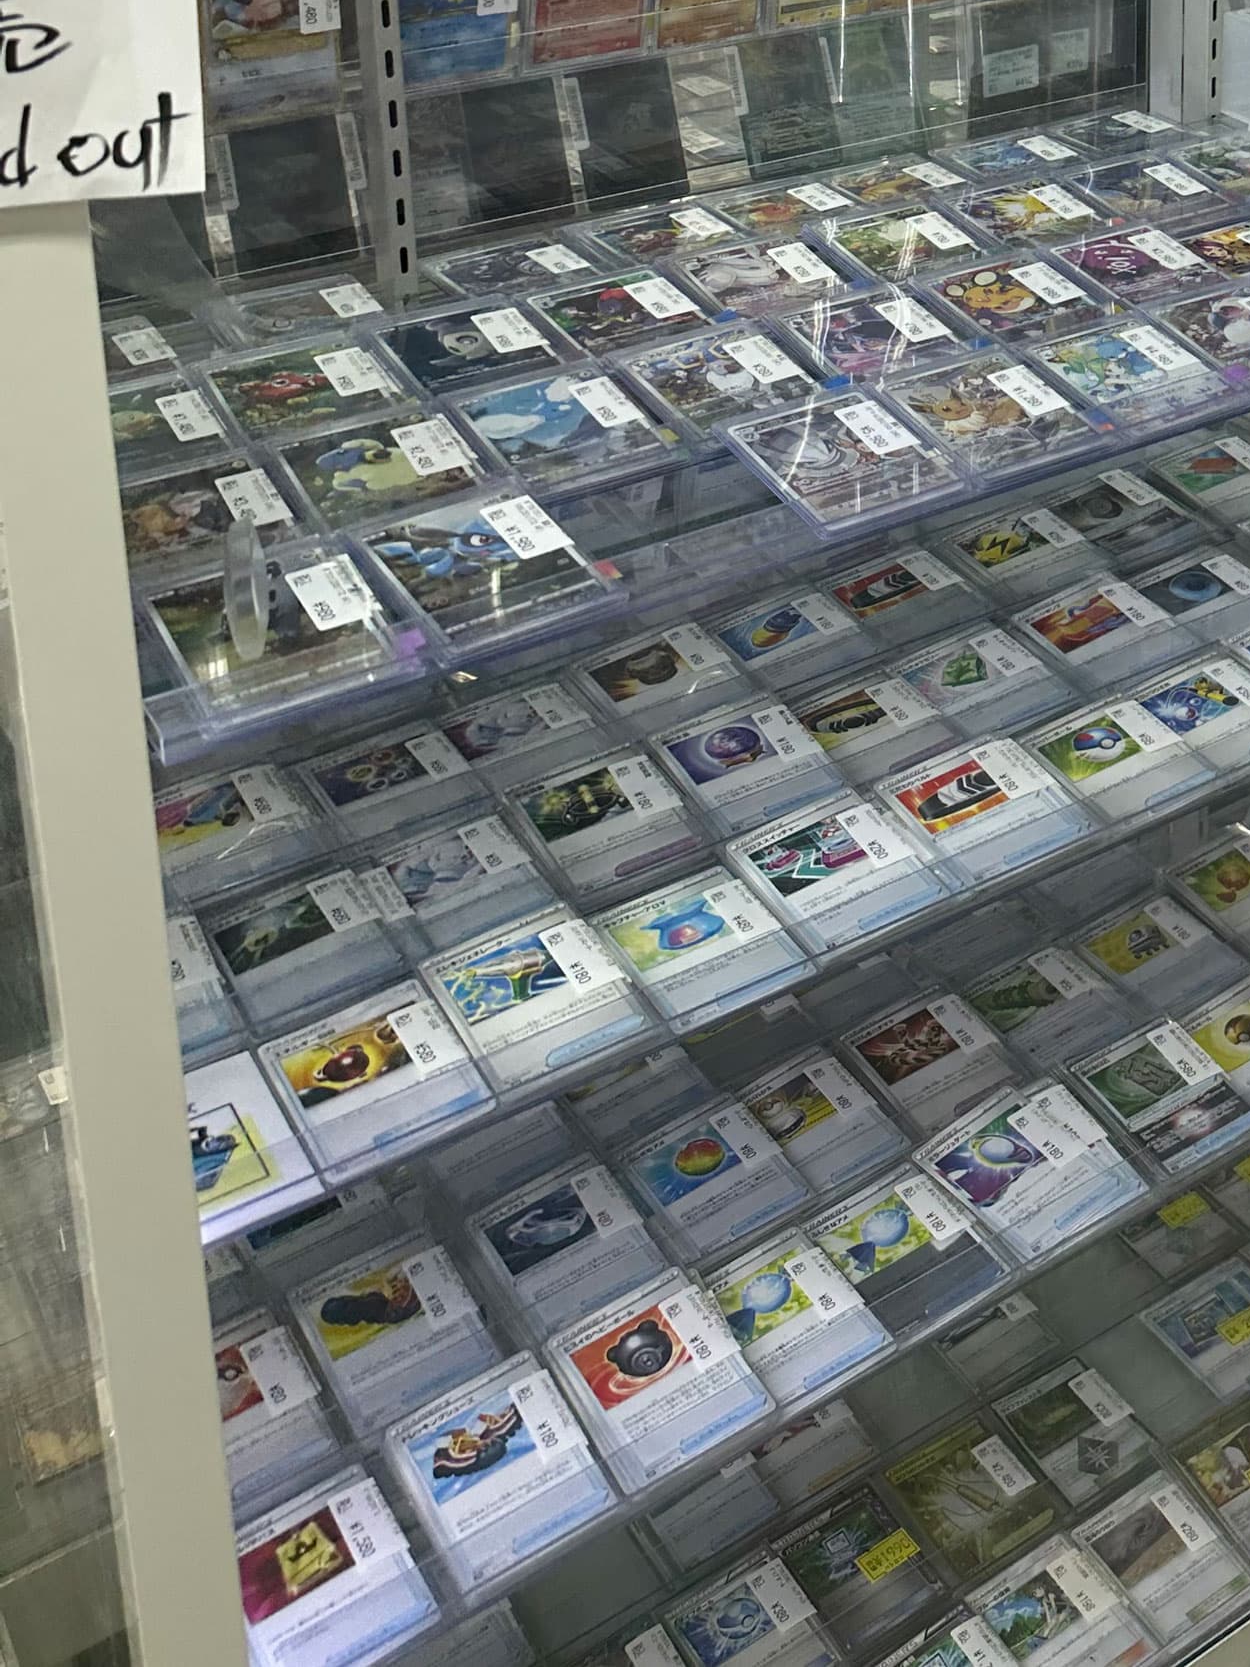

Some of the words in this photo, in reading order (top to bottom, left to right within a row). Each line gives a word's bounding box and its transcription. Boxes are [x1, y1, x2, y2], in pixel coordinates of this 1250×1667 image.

[60, 97, 201, 202] out
[997, 772, 1019, 792] ¥180
[867, 840, 890, 859] ¥280
[568, 962, 593, 986] ¥180
[1041, 1140, 1065, 1162] ¥180
[925, 1210, 948, 1232] ¥180
[426, 1293, 447, 1317] ¥180
[689, 1333, 713, 1360] ¥180
[536, 1419, 559, 1448] ¥180
